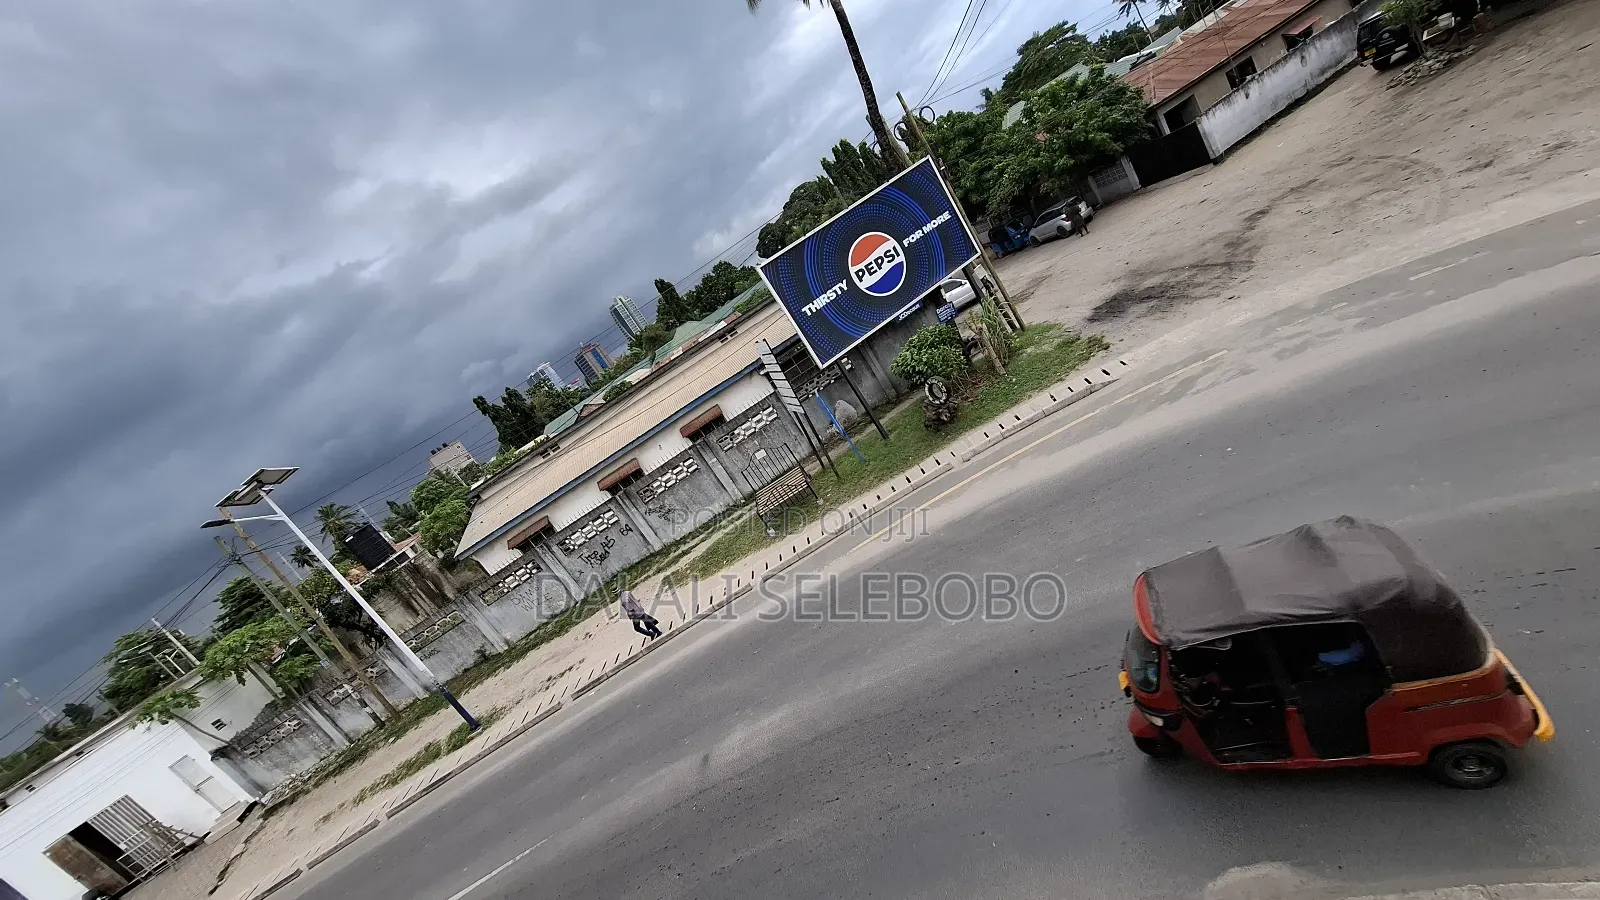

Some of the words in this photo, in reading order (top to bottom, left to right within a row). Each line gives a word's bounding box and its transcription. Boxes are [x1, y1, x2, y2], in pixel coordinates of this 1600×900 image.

[801, 279, 848, 316] THIRSTY
[902, 229, 924, 248] FOR
[922, 211, 952, 234] MORE
[854, 245, 900, 282] PEPSI
